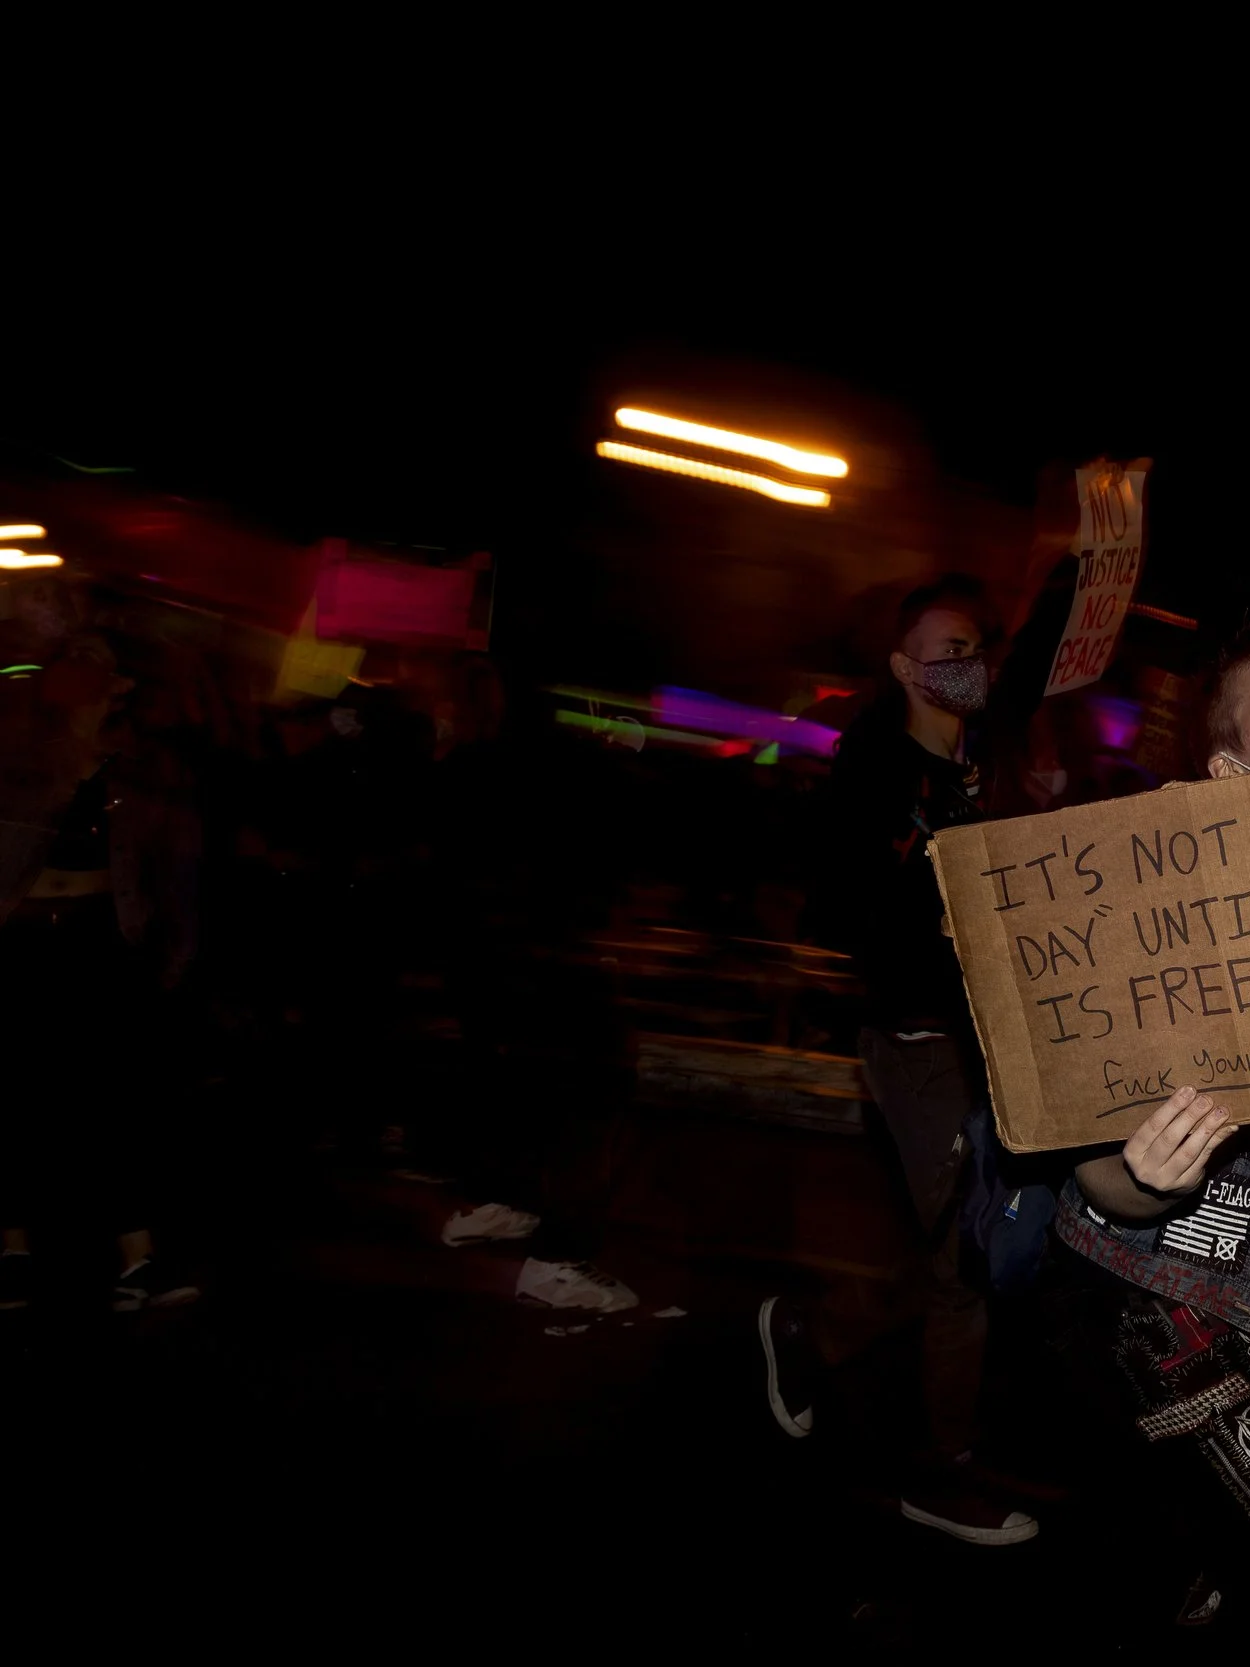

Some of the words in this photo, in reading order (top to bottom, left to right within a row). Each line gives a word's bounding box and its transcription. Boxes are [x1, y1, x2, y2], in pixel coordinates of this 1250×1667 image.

[1086, 479, 1128, 544] NO
[1078, 547, 1139, 592] JUSTICE
[1080, 593, 1117, 630] NO
[1050, 635, 1112, 686] PEACE
[980, 835, 1103, 911] IT'S
[1131, 819, 1238, 884] NOT
[1036, 985, 1113, 1043] IS
